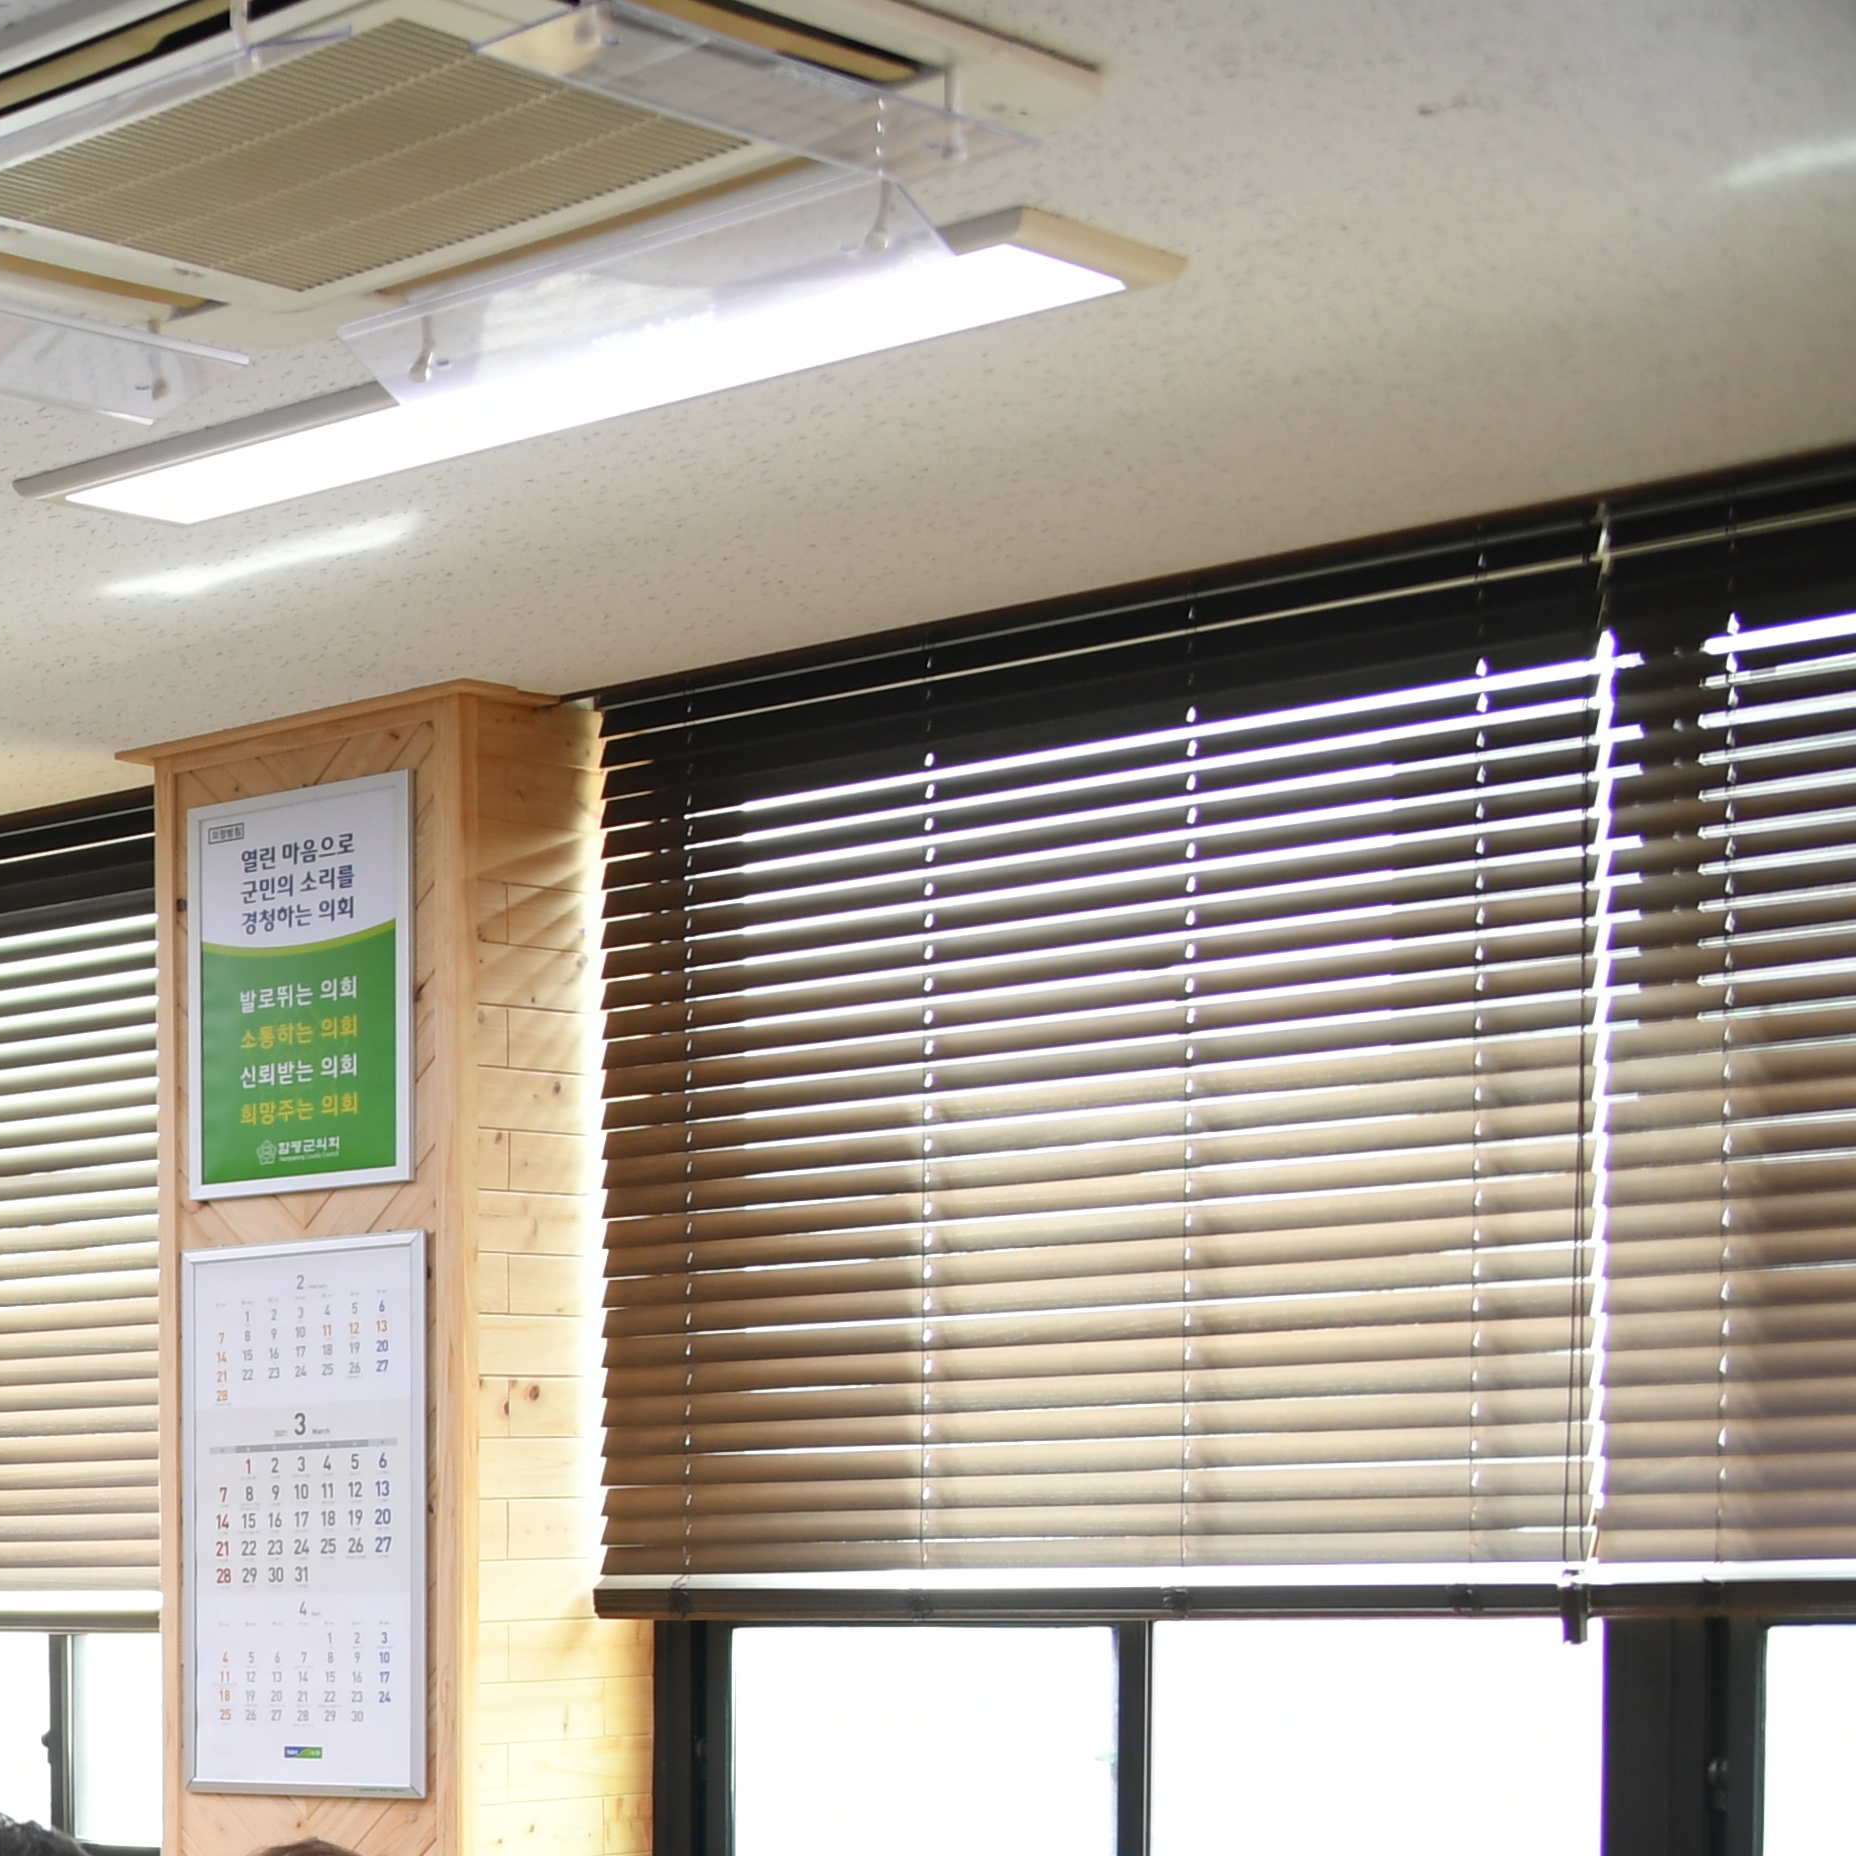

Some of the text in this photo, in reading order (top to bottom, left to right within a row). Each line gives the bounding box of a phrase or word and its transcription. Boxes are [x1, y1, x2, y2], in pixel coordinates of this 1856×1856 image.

[241, 833, 355, 874] 열린 마음으로
[240, 864, 355, 905] 군민의 소리를
[241, 895, 354, 935] 경청하는 의회
[239, 975, 358, 1015] 발로뛰는 의회
[239, 1014, 358, 1051] 소통하는 의회
[239, 1053, 358, 1090] 신뢰받는 의회
[239, 1091, 359, 1127] 희망주는 의회
[296, 1274, 305, 1290] 2
[245, 1300, 386, 1323] 1 2 3 4 5 6
[218, 1320, 388, 1344] 7 8 9 10 11 12 13
[216, 1340, 389, 1364] 14 15 16 17 18 19 20
[216, 1360, 389, 1383] 21 22 23 24 25 26 27
[216, 1390, 228, 1402] 28
[293, 1412, 306, 1436] 3
[245, 1452, 387, 1475] 1 2 3 4 5 6
[219, 1480, 390, 1503] 7 8 9 10 11 12 13
[216, 1508, 391, 1530] 14 15 16 17 18 19 20
[216, 1536, 392, 1557] 21 22 23 24 25 26 27
[216, 1566, 309, 1584] 28 29 30 31
[299, 1600, 307, 1616] 4
[327, 1632, 388, 1644] 1 2 3
[222, 1651, 390, 1664] 4 5 6 7 8 9 10
[220, 1671, 390, 1683] 11 12 13 14 15 16 17
[219, 1690, 392, 1703] 18 19 20 21 22 23 24
[219, 1709, 364, 1722] 25 26 27 28 29 30
